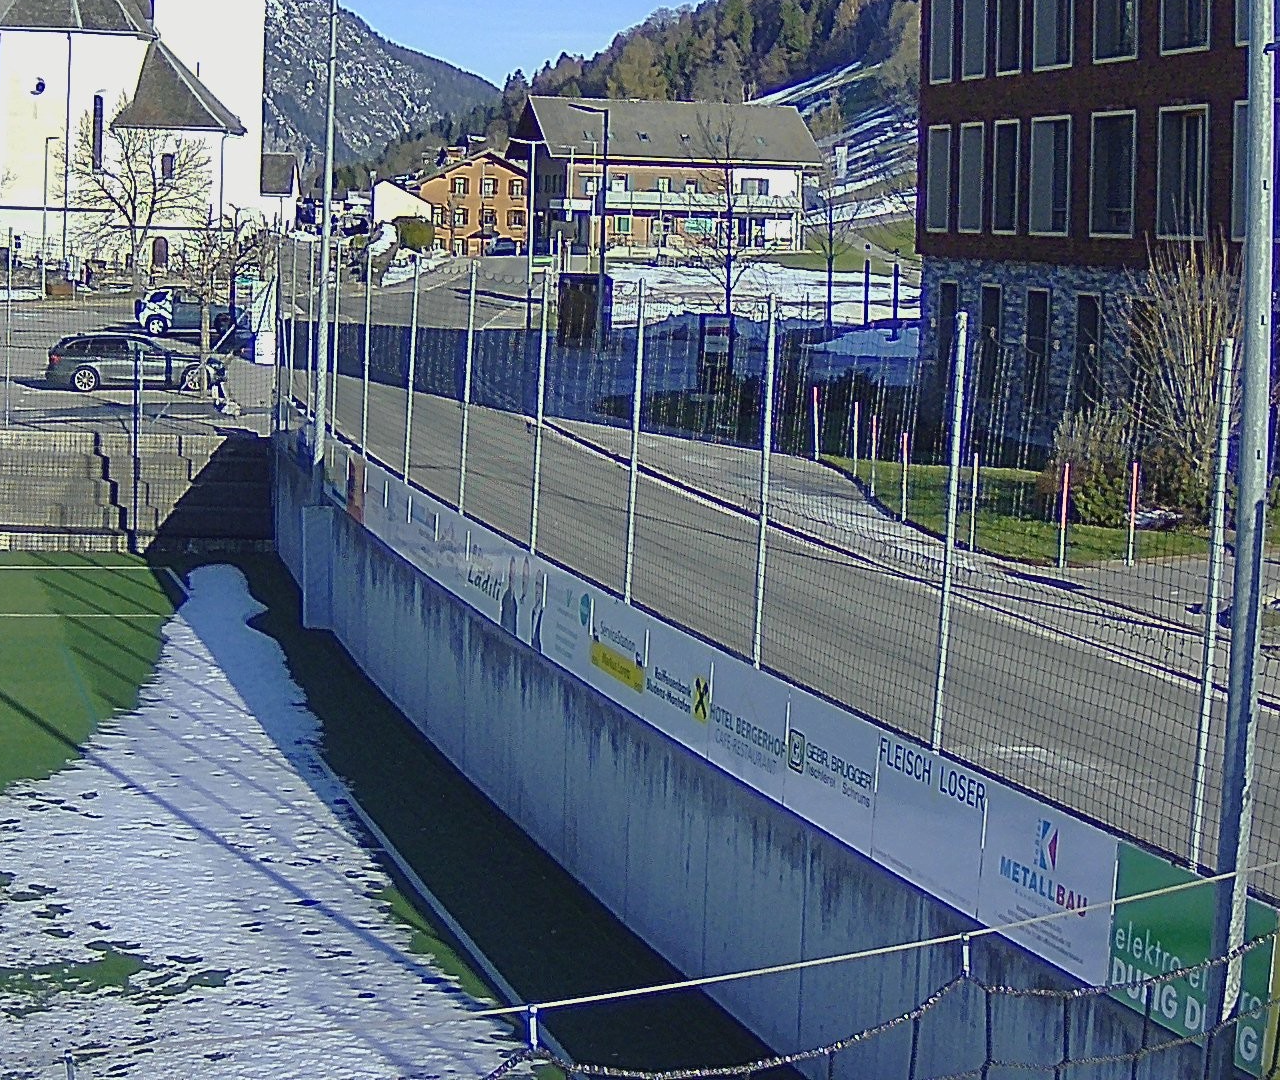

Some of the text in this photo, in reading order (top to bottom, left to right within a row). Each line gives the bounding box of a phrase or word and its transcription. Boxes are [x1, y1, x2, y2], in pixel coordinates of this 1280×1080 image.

[710, 704, 734, 731] HOTEL
[736, 717, 786, 759] BERGERHOF
[831, 755, 873, 790] BRUGGER
[879, 737, 986, 812] FLEISCH LOSER
[999, 856, 1088, 918] METALLBAU
[1114, 921, 1182, 972] elektro
